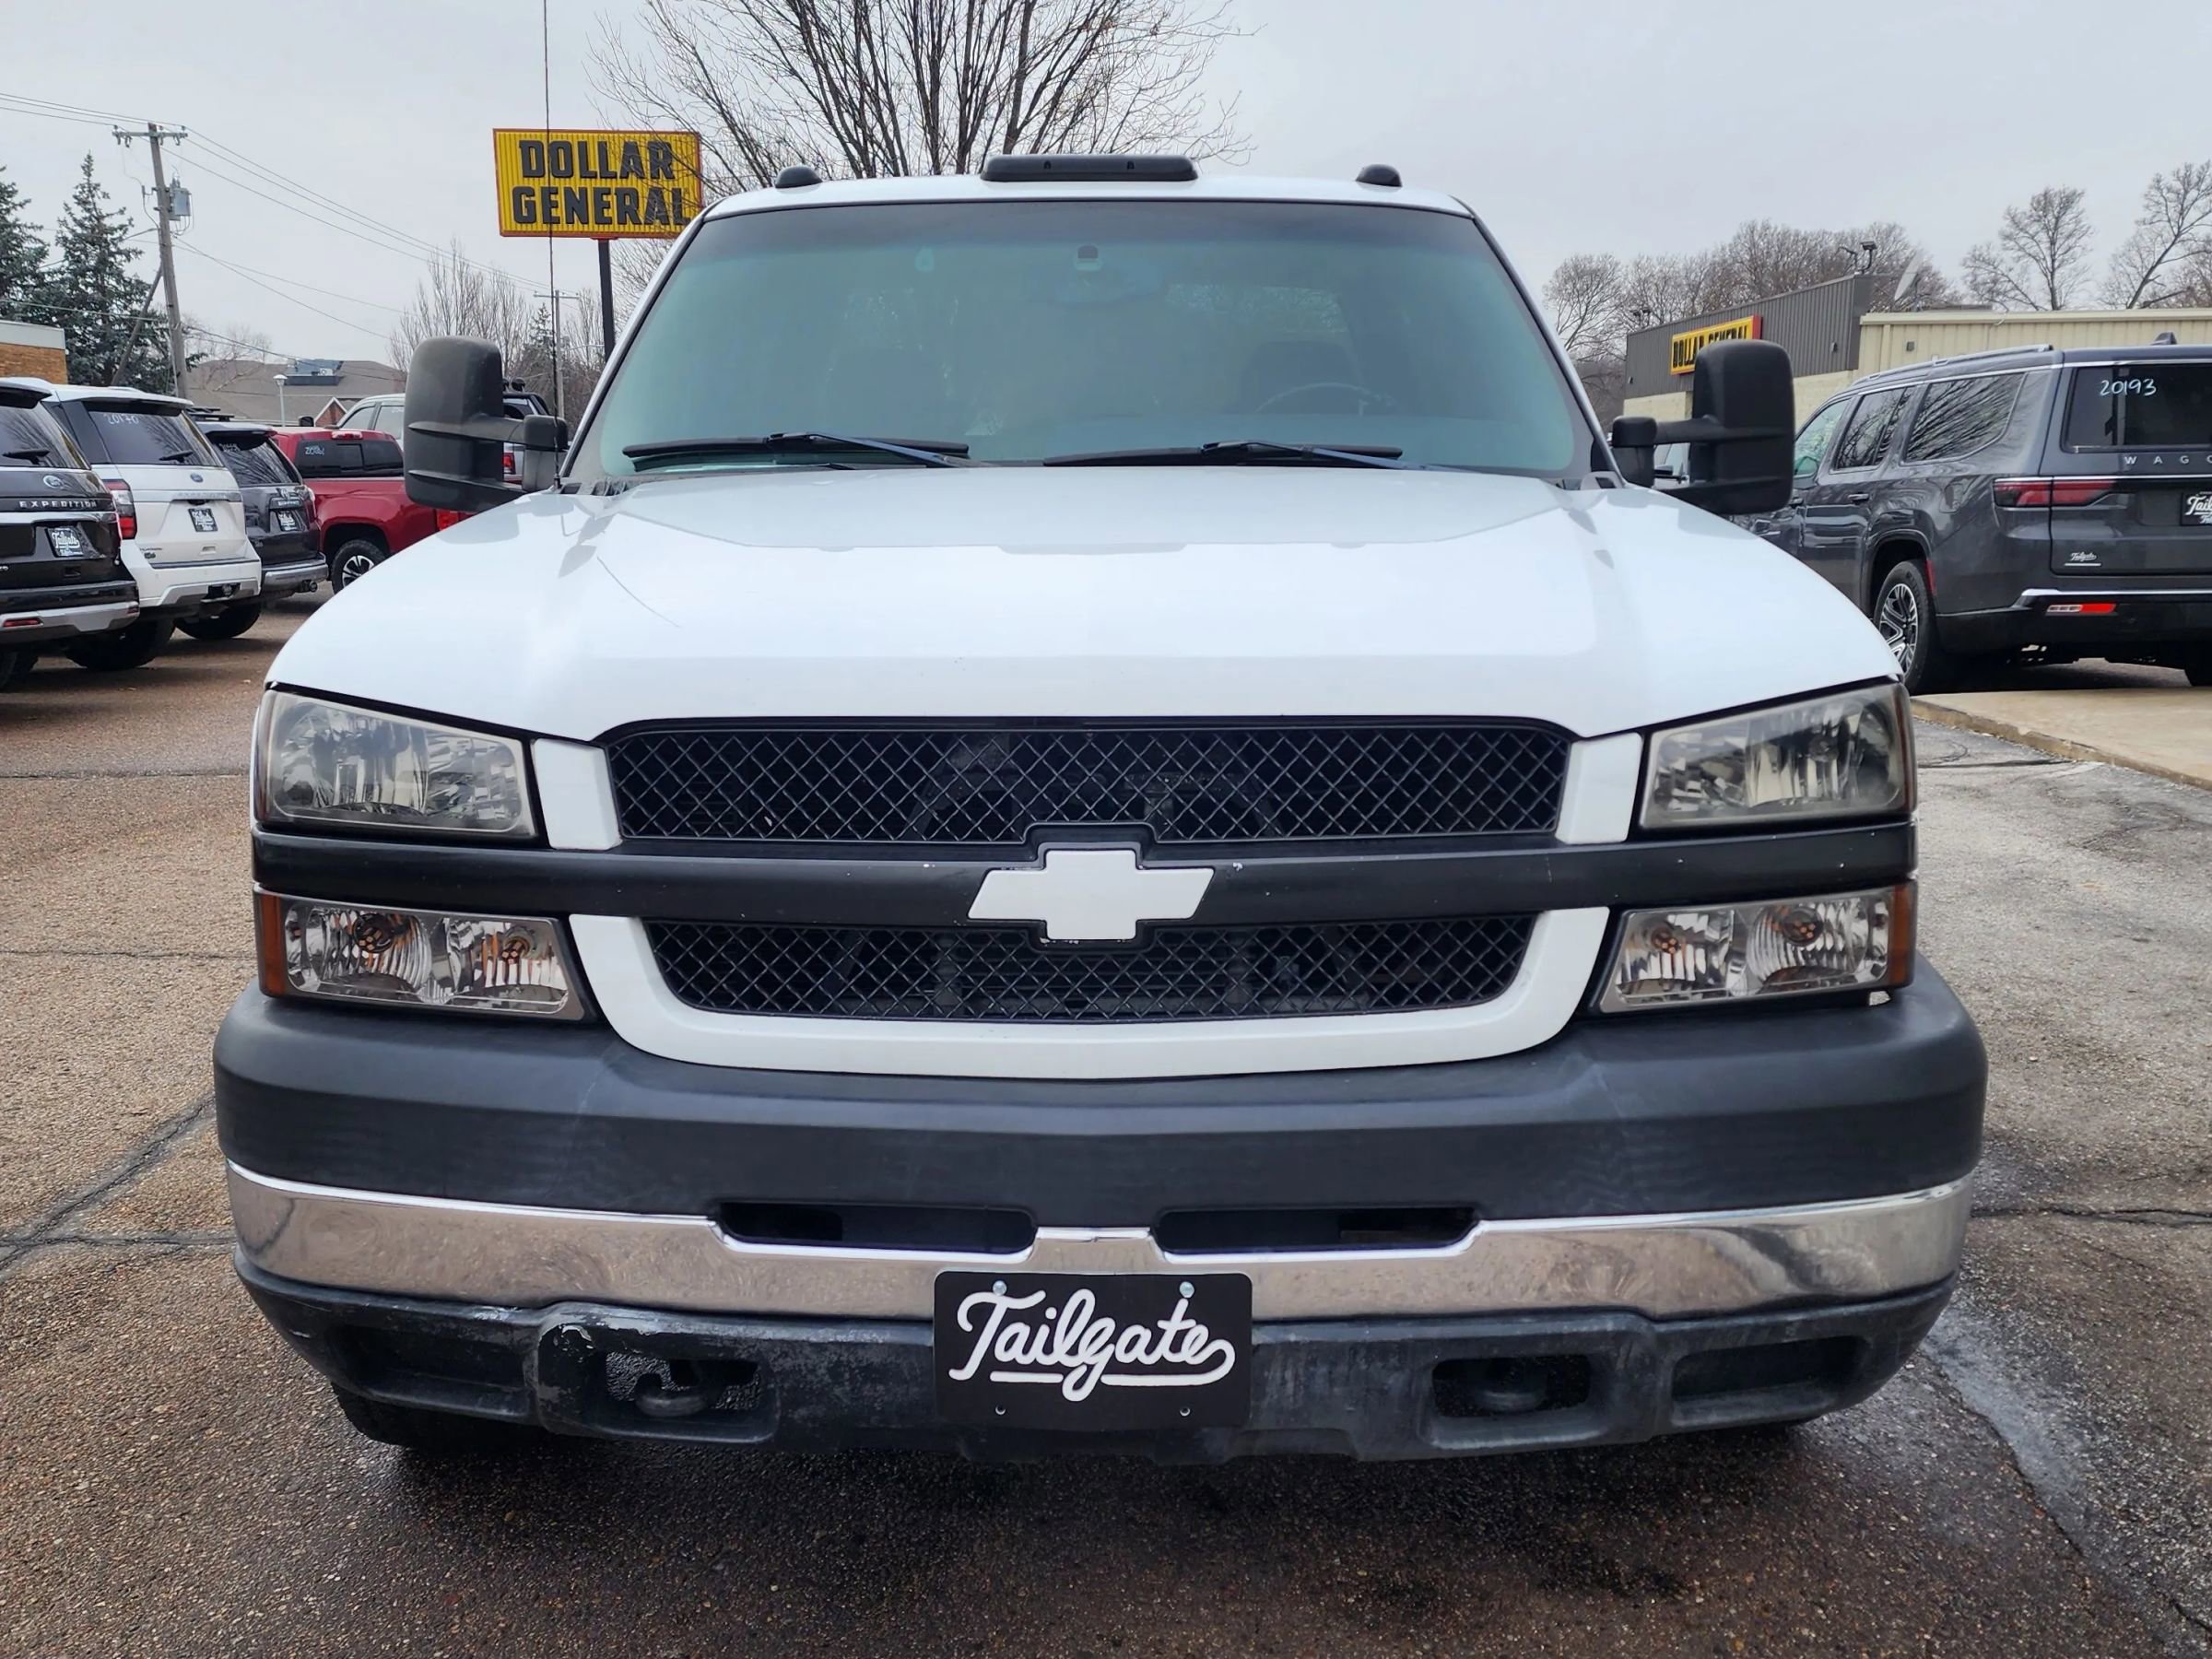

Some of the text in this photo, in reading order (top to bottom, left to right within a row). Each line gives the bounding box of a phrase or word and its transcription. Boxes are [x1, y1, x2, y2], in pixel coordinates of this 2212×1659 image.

[519, 140, 676, 180] DOLLAR
[512, 186, 691, 226] GENERAL
[2100, 378, 2157, 396] 20193
[948, 1288, 1236, 1402] Tailgate
